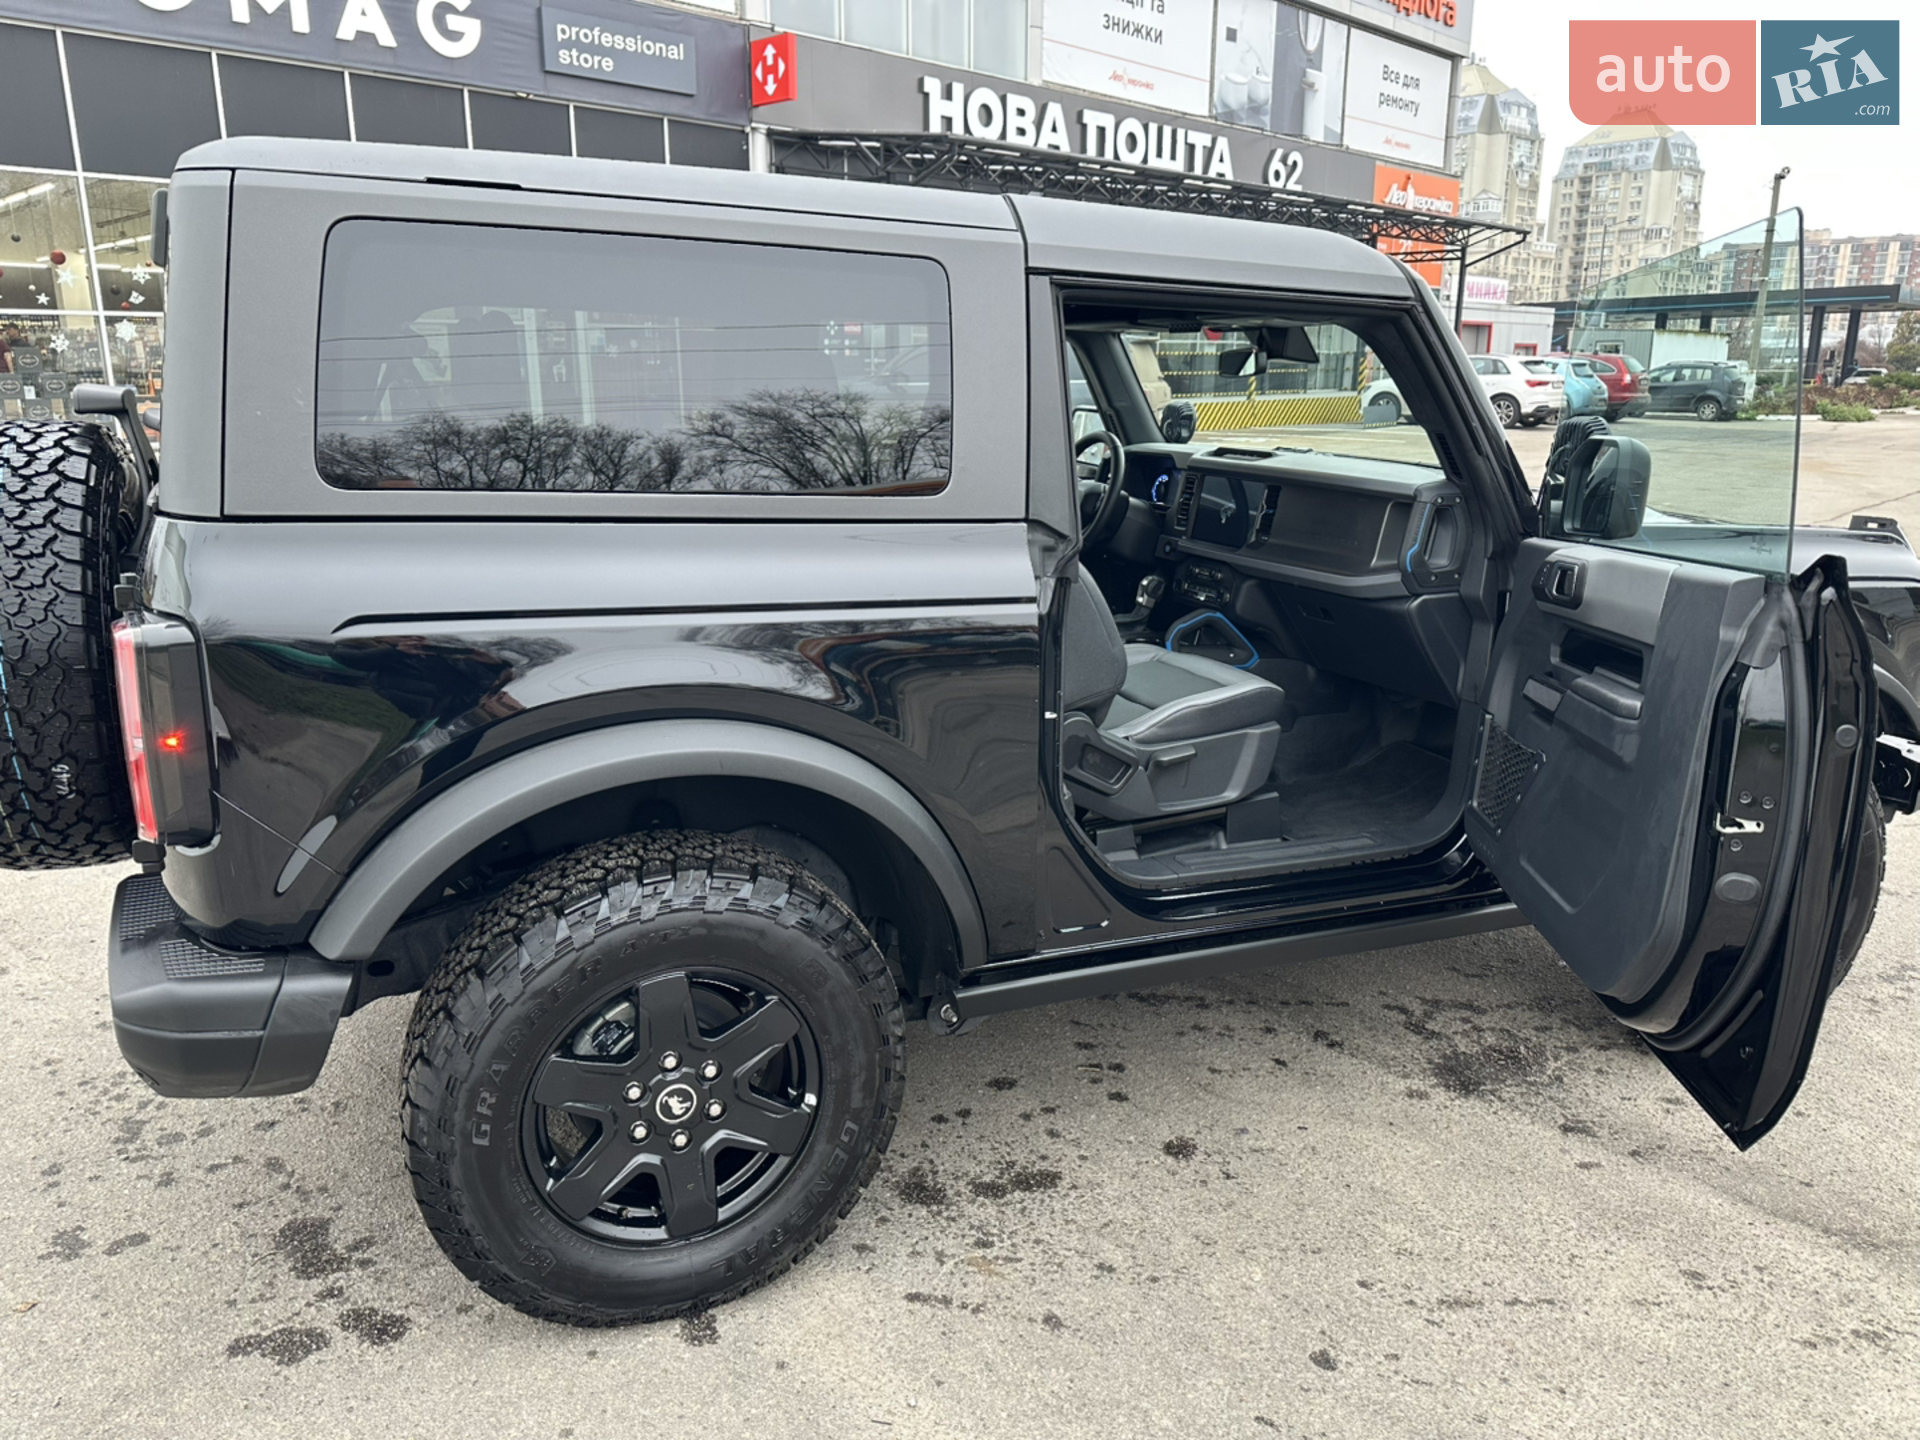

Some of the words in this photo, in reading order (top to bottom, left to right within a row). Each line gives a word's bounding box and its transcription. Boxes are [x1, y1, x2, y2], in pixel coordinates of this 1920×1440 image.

[556, 23, 684, 60] professional
[1102, 13, 1163, 45] знижки
[558, 48, 614, 72] store
[1382, 64, 1401, 84] Все
[1401, 74, 1421, 91] для
[1378, 92, 1421, 117] ремонту
[923, 75, 1072, 152] НОВА
[1081, 108, 1234, 180] ПОШТА
[1267, 147, 1304, 190] 62
[469, 957, 604, 1147] GRABBER
[708, 1118, 860, 1279] GENERAL
